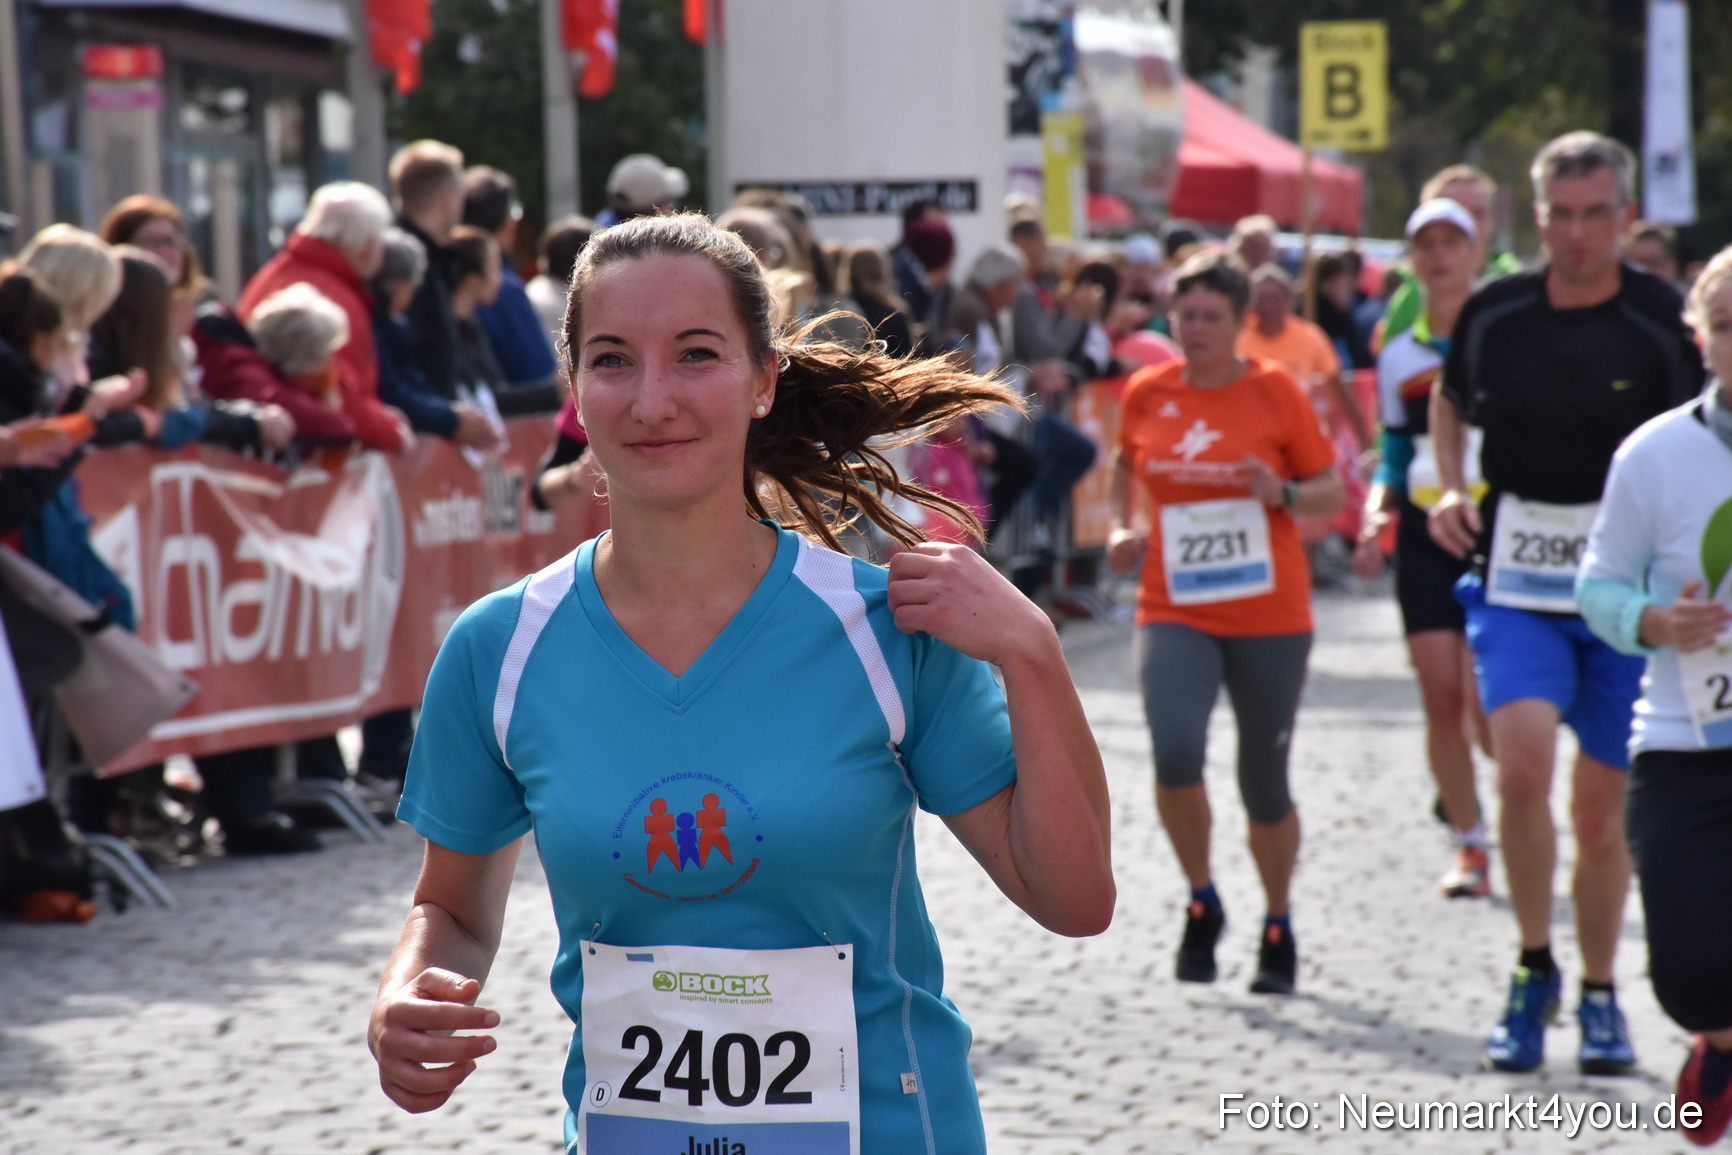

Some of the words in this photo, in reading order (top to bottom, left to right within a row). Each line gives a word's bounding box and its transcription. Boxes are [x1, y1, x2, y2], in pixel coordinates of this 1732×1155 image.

[1324, 62, 1364, 121] B
[1178, 529, 1249, 565] 2231
[612, 781, 659, 840] Elterninitiative
[660, 771, 724, 785] krebskranker
[724, 781, 750, 807] Kinder
[679, 971, 771, 996] BOCK
[679, 993, 708, 1002] inspired
[708, 995, 717, 1004] by
[740, 997, 773, 1006] concepts
[618, 1025, 812, 1107] 2402
[596, 1088, 605, 1102] D
